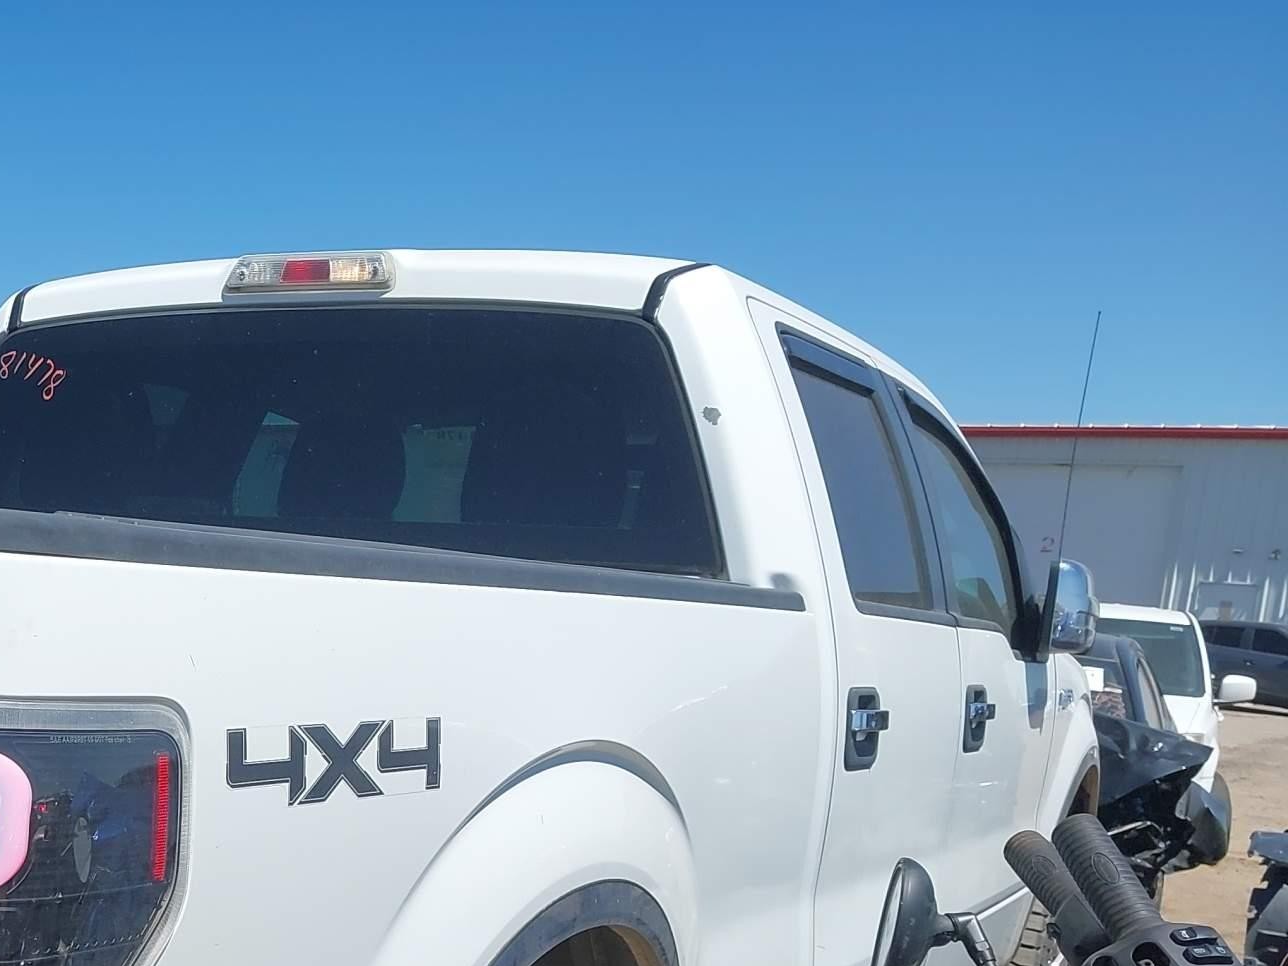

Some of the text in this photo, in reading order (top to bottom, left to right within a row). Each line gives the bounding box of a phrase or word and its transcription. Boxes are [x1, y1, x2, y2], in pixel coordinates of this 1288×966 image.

[0, 350, 67, 400] 81478
[1040, 536, 1055, 553] 2
[226, 717, 441, 806] 4X4
